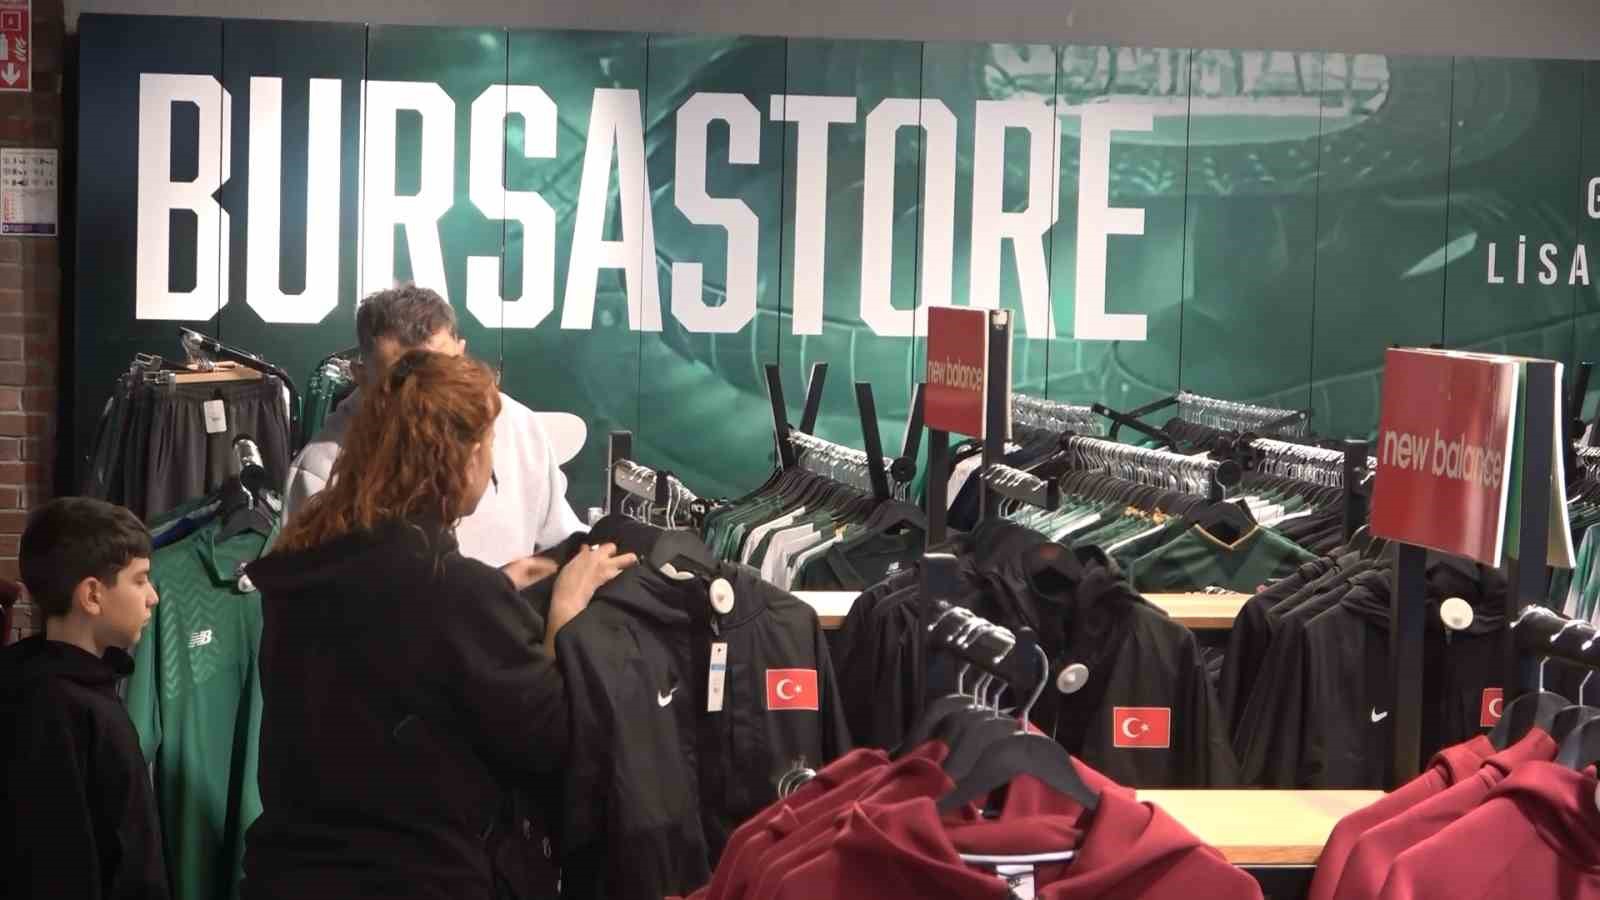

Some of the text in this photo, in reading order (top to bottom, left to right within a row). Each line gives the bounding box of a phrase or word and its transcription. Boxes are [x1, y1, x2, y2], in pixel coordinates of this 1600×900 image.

[135, 72, 1153, 341] BURSASTORE
[1487, 234, 1590, 285] LİSA
[946, 354, 983, 391] balance
[1383, 427, 1502, 489] new balance
